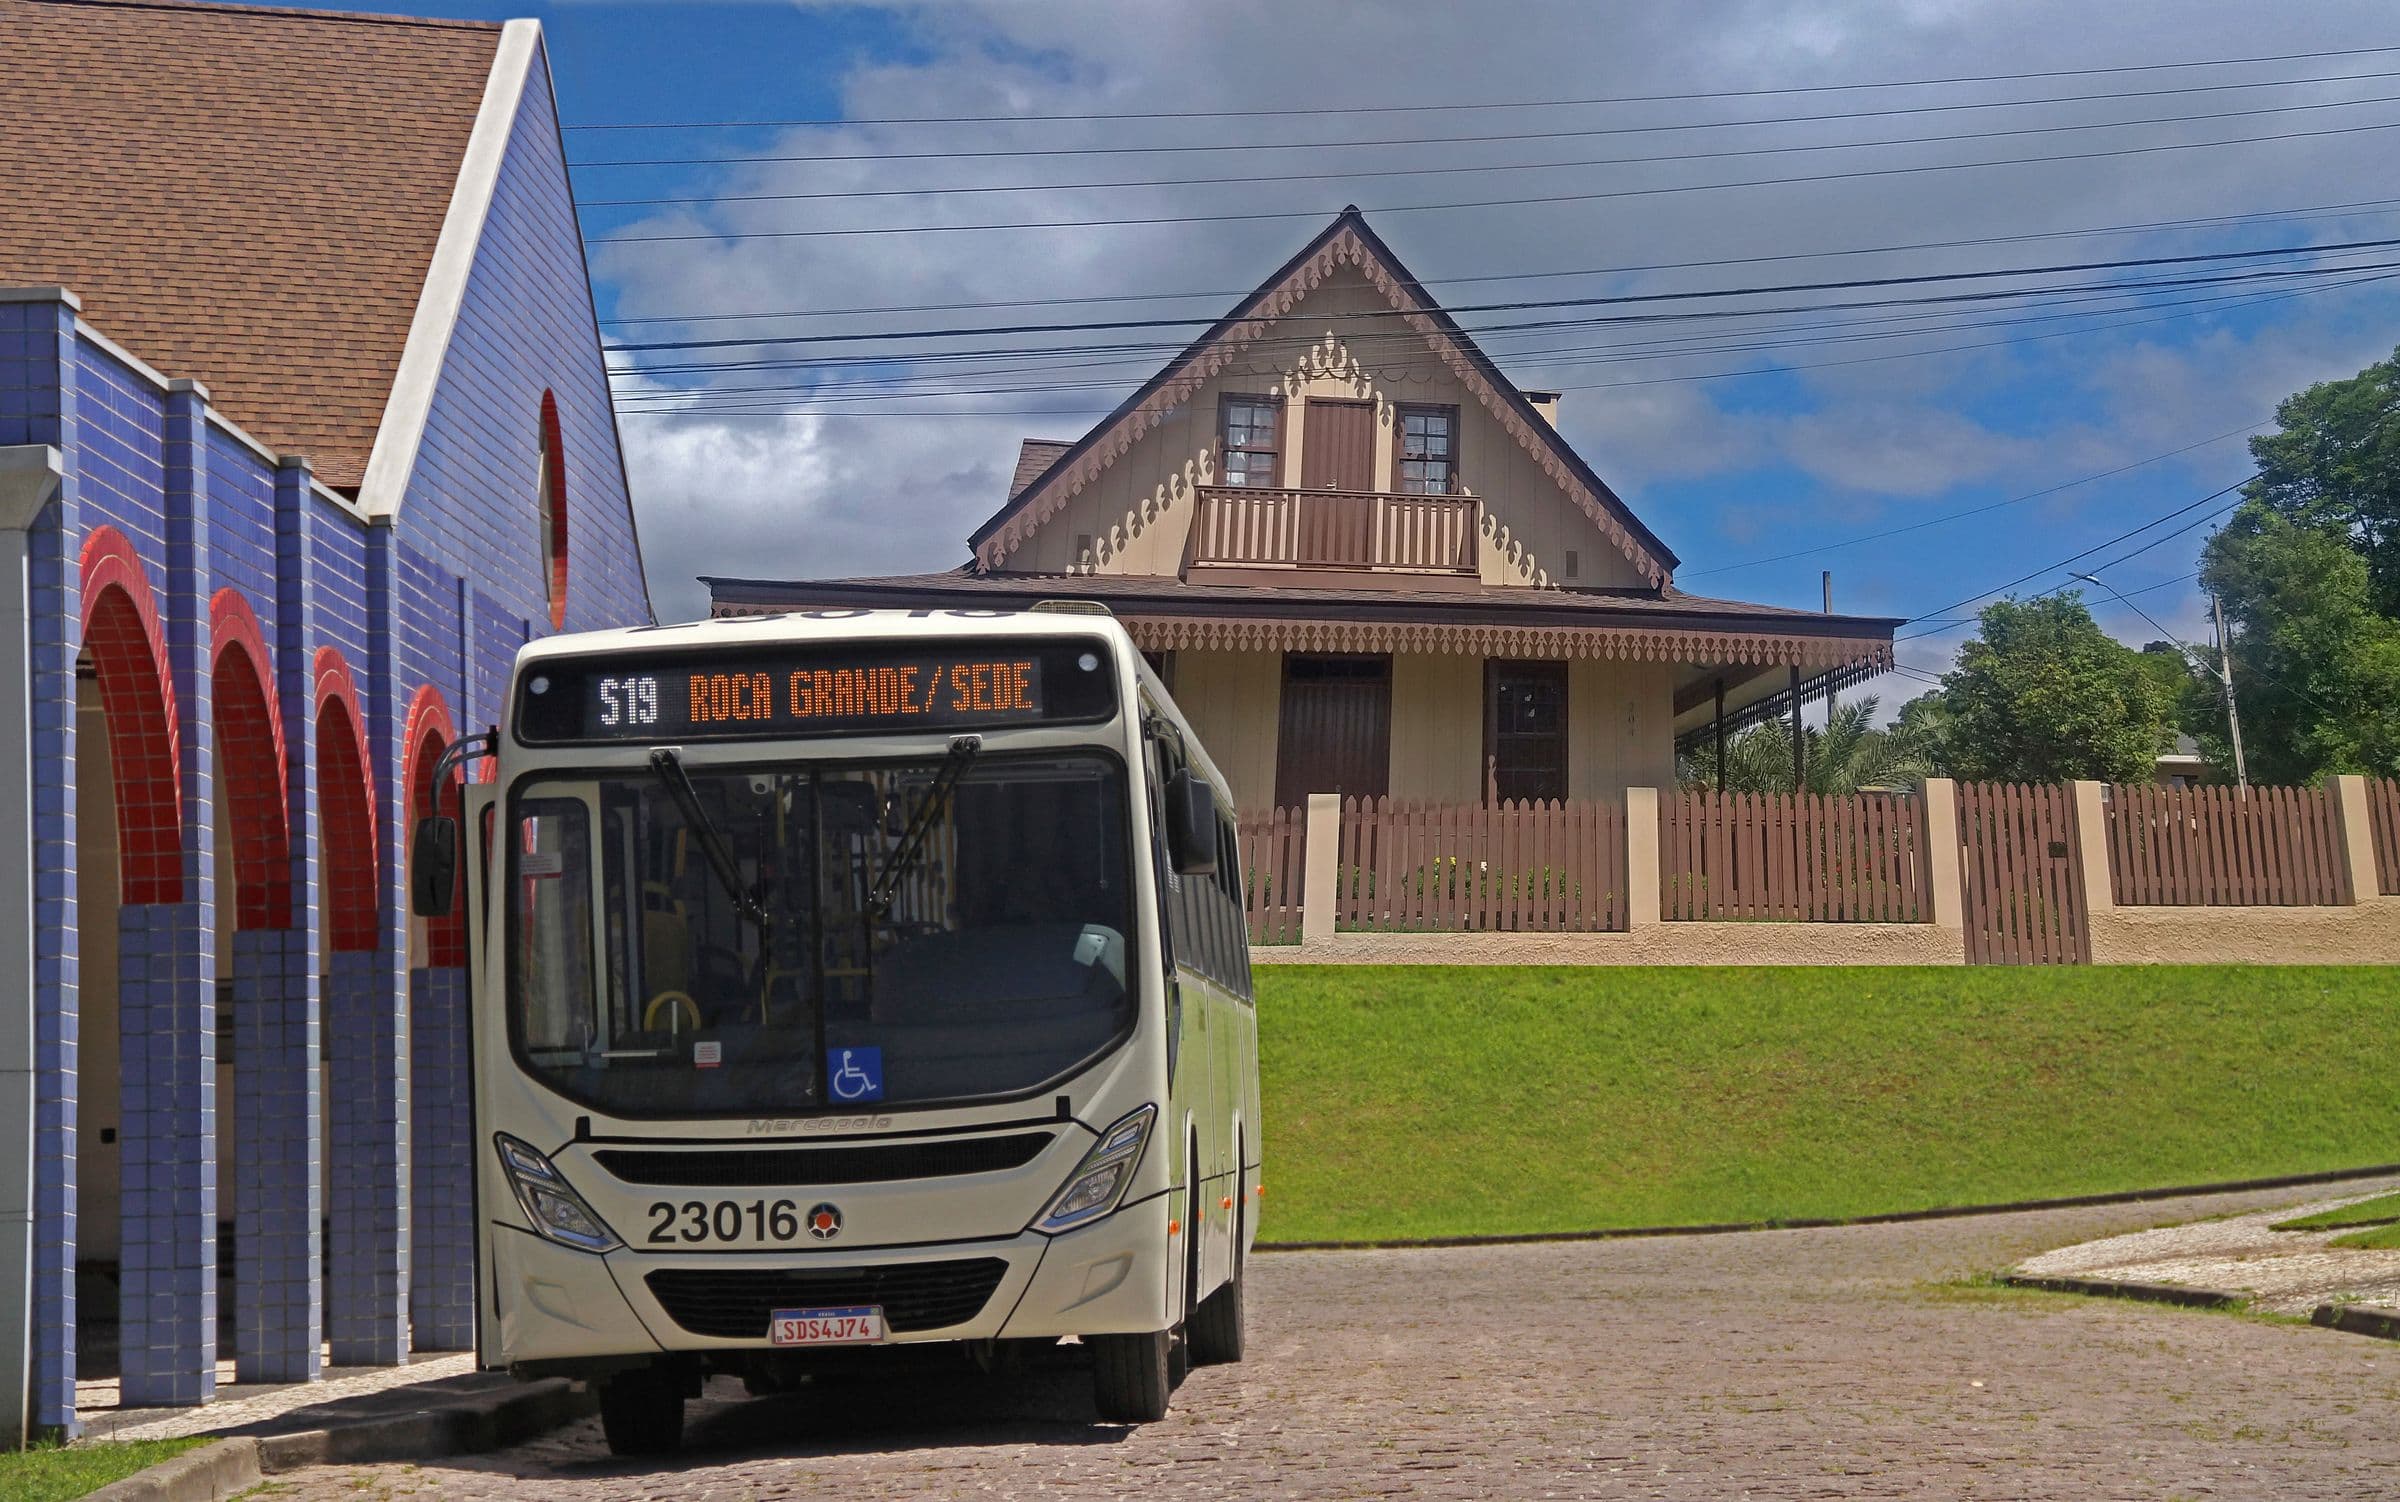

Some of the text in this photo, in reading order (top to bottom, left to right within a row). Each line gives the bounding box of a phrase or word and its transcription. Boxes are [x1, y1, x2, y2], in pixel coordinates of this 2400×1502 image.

[601, 678, 657, 724] S19
[690, 673, 772, 722] ROCA
[747, 1115, 893, 1134] Marcopolo
[648, 1199, 798, 1243] 23016
[784, 1318, 869, 1340] SDS4J74
